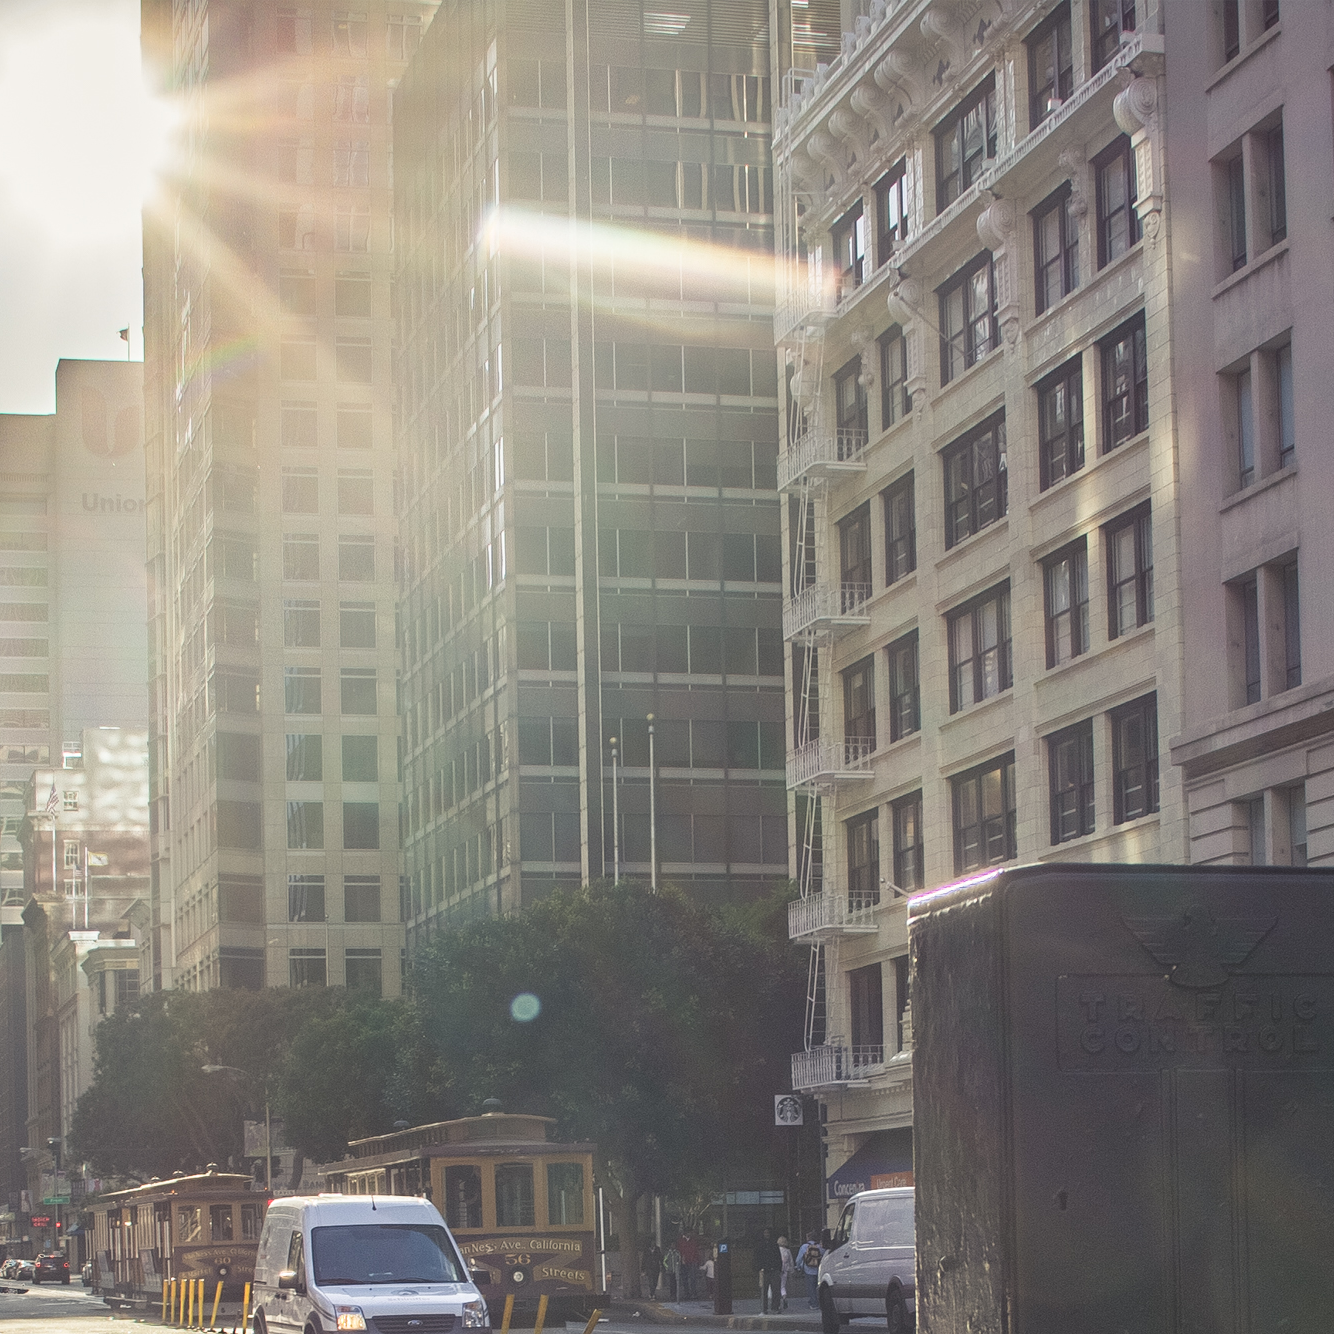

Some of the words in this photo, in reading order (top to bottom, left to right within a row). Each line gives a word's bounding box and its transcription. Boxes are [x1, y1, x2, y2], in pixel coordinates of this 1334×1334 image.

[1078, 989, 1318, 1023] TRAFFIC
[1079, 1023, 1320, 1056] CONTROL
[894, 1175, 908, 1188] Care
[459, 1246, 471, 1254] an
[529, 1239, 582, 1252] California
[214, 1256, 232, 1265] 60
[505, 1253, 531, 1266] 56
[541, 1267, 586, 1281] Streets
